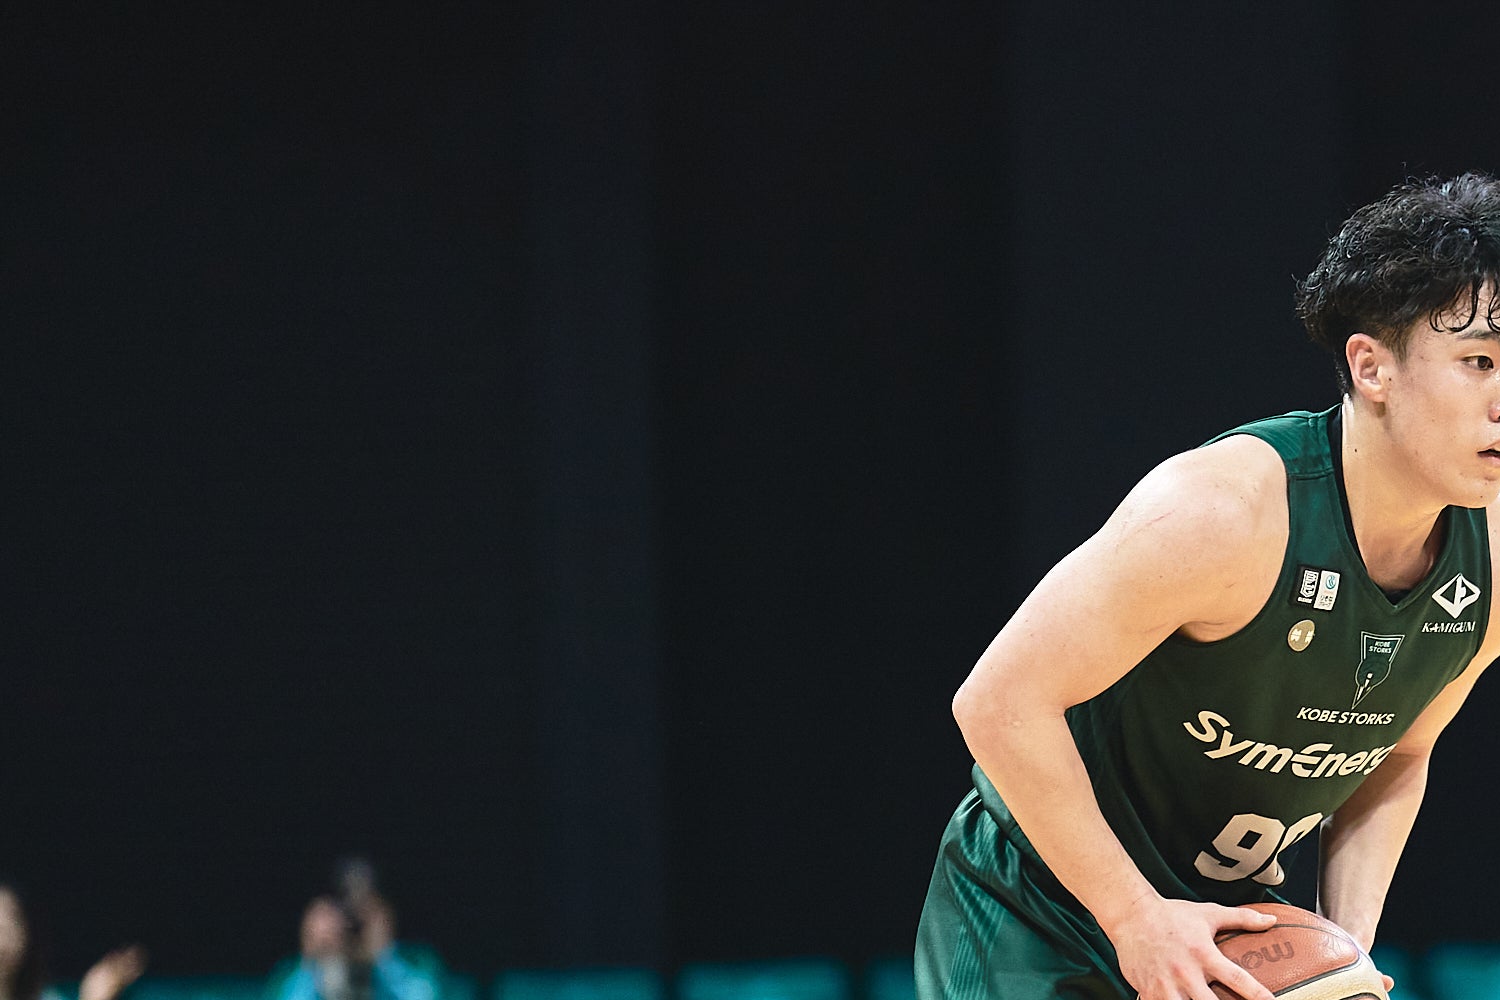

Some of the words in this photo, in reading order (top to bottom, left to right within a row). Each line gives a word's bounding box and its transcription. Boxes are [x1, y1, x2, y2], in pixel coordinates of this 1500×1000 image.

[1368, 646, 1392, 654] STORKS
[1296, 707, 1337, 722] KOBE
[1338, 711, 1395, 725] STORKS
